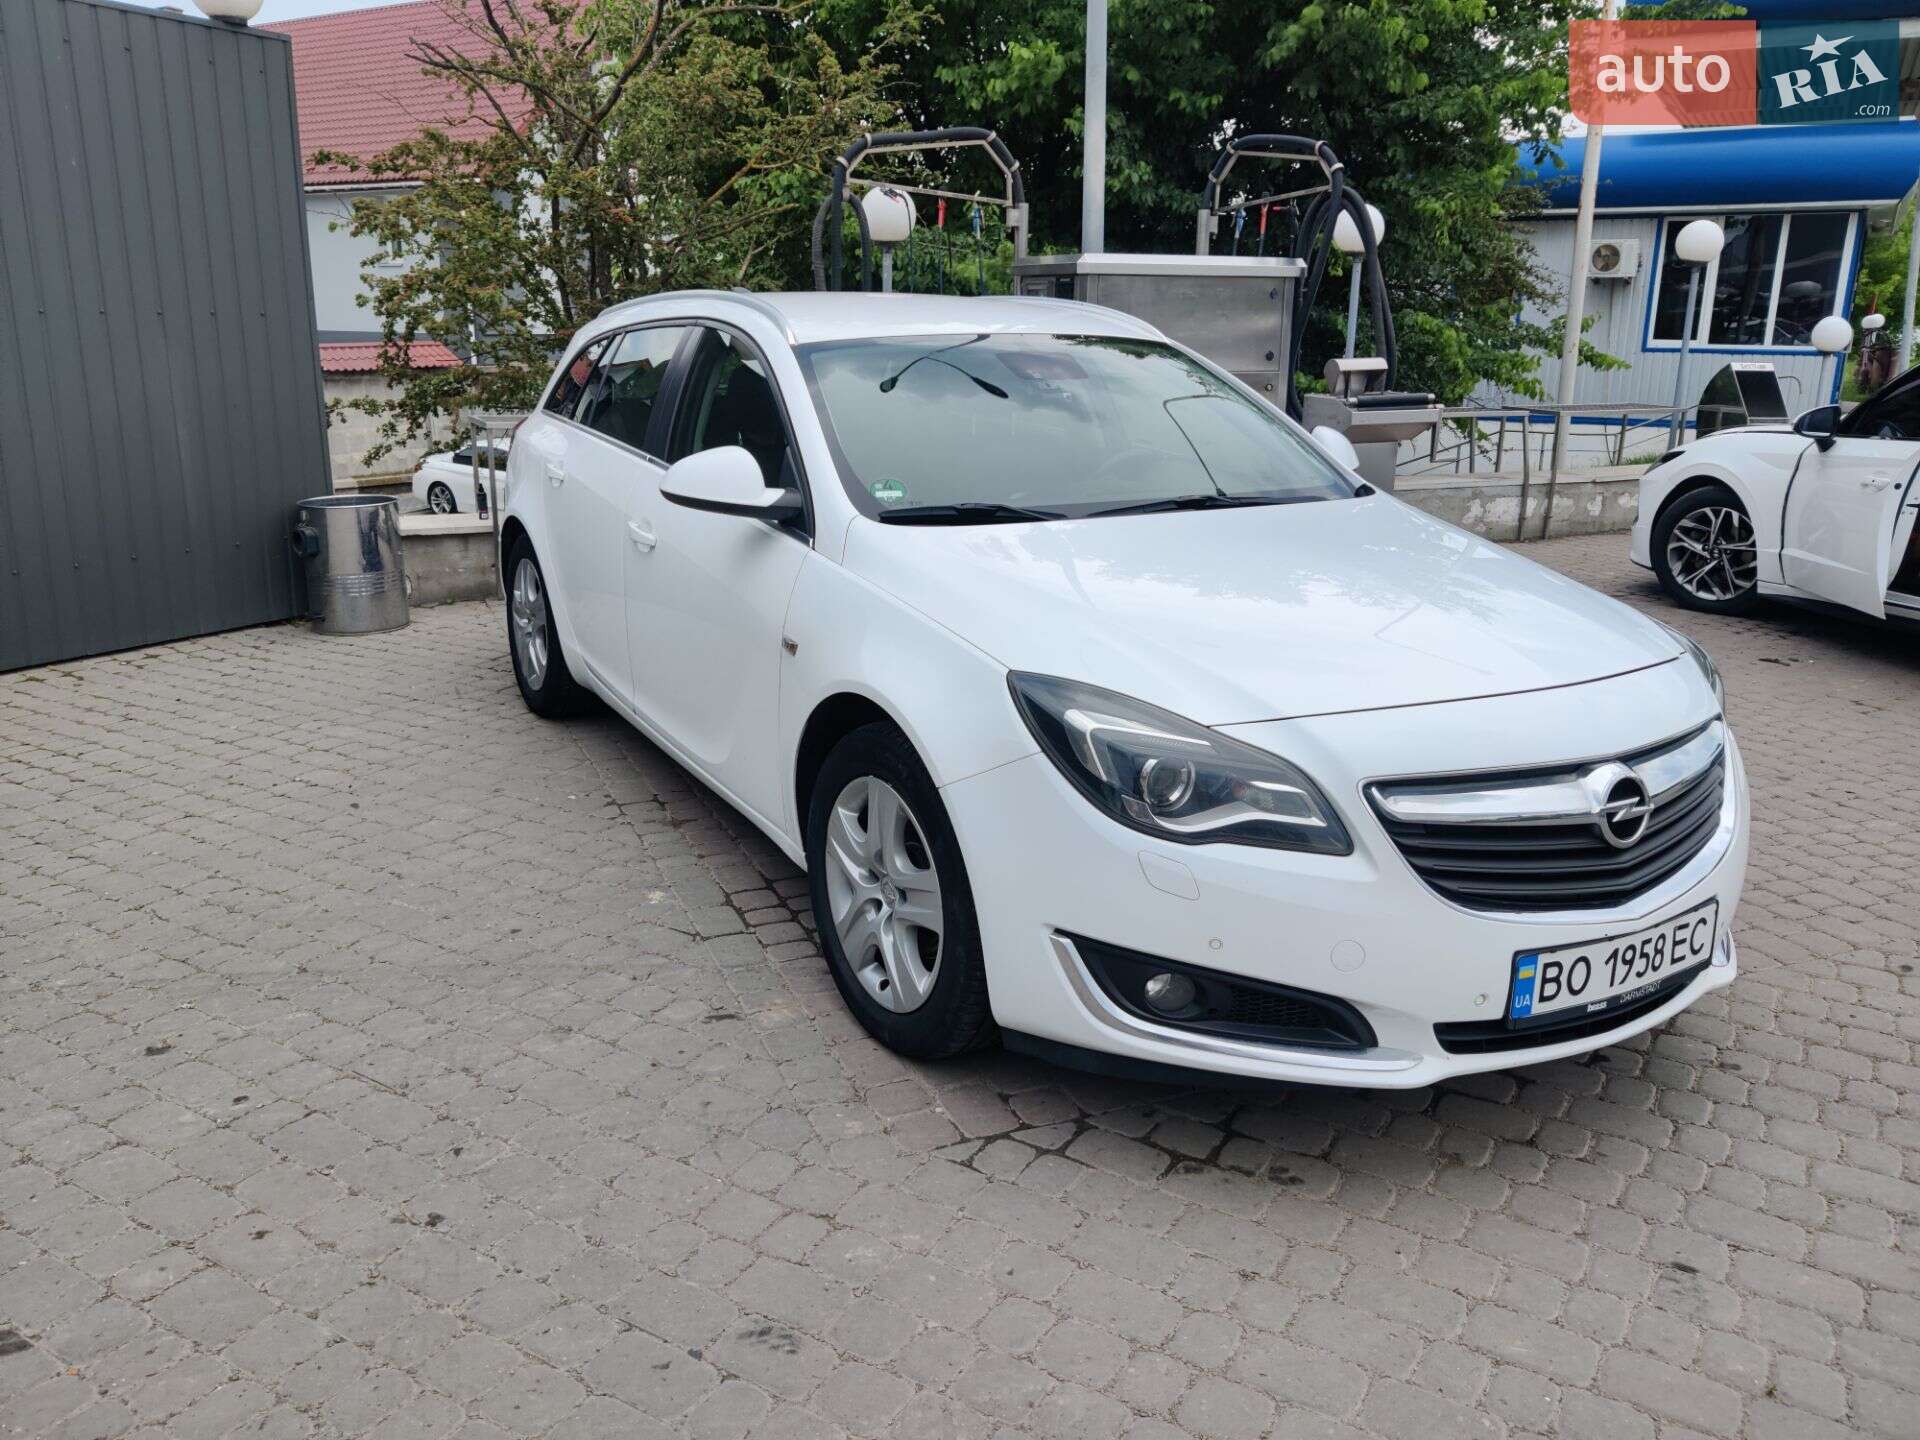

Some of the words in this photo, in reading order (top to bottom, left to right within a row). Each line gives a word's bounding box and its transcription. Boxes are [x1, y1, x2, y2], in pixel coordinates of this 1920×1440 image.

[1538, 955, 1592, 1003] BO
[1604, 932, 1667, 988] 1958
[1670, 917, 1708, 966] EC
[1515, 995, 1531, 1008] UA
